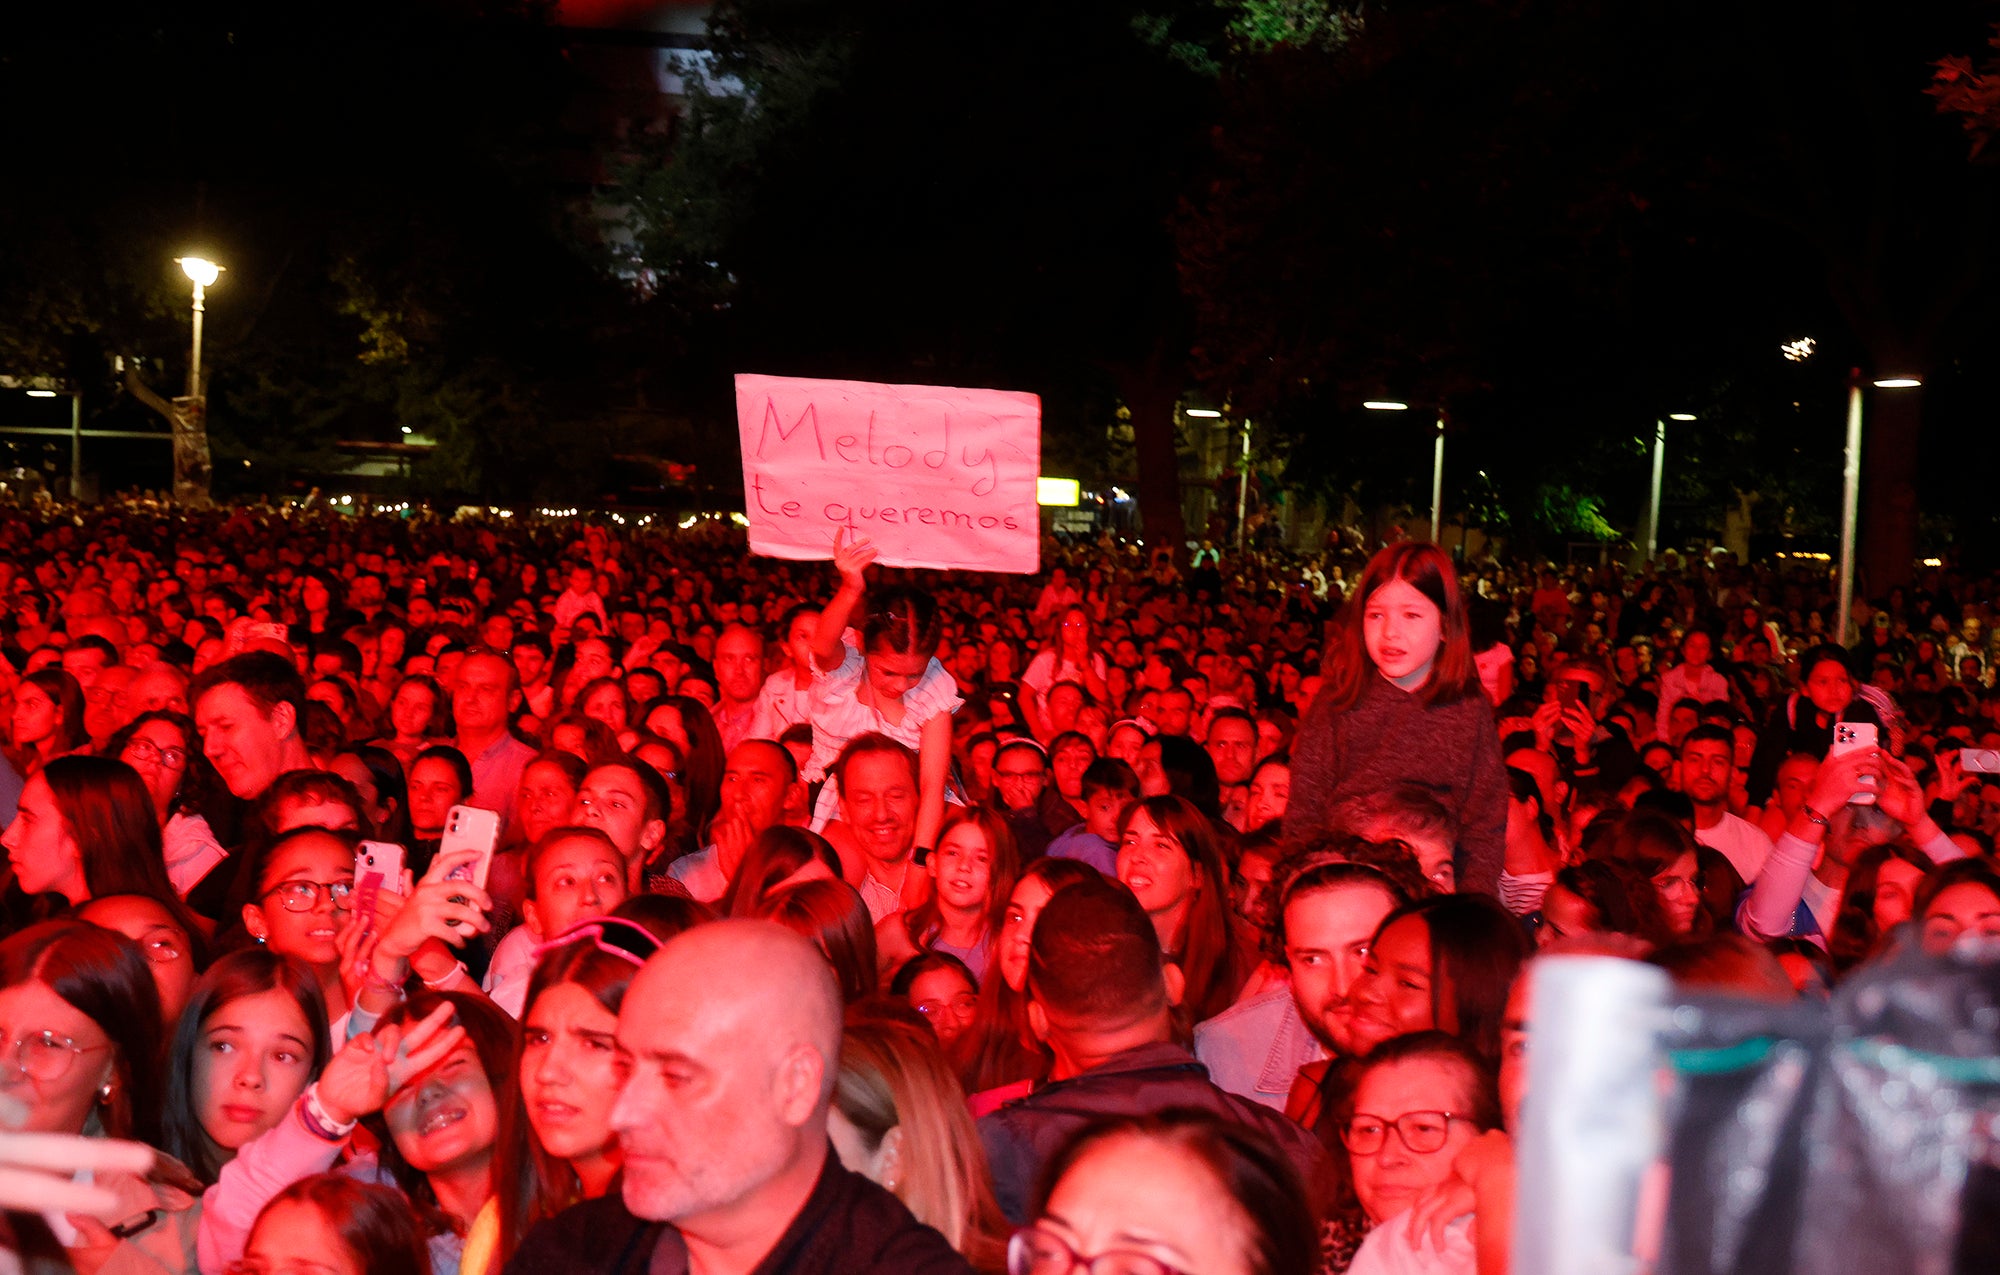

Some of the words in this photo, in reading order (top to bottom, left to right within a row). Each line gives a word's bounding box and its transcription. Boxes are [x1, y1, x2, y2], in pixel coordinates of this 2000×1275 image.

[756, 396, 997, 497] Melody
[751, 474, 801, 518] te
[823, 503, 1018, 544] queremos
